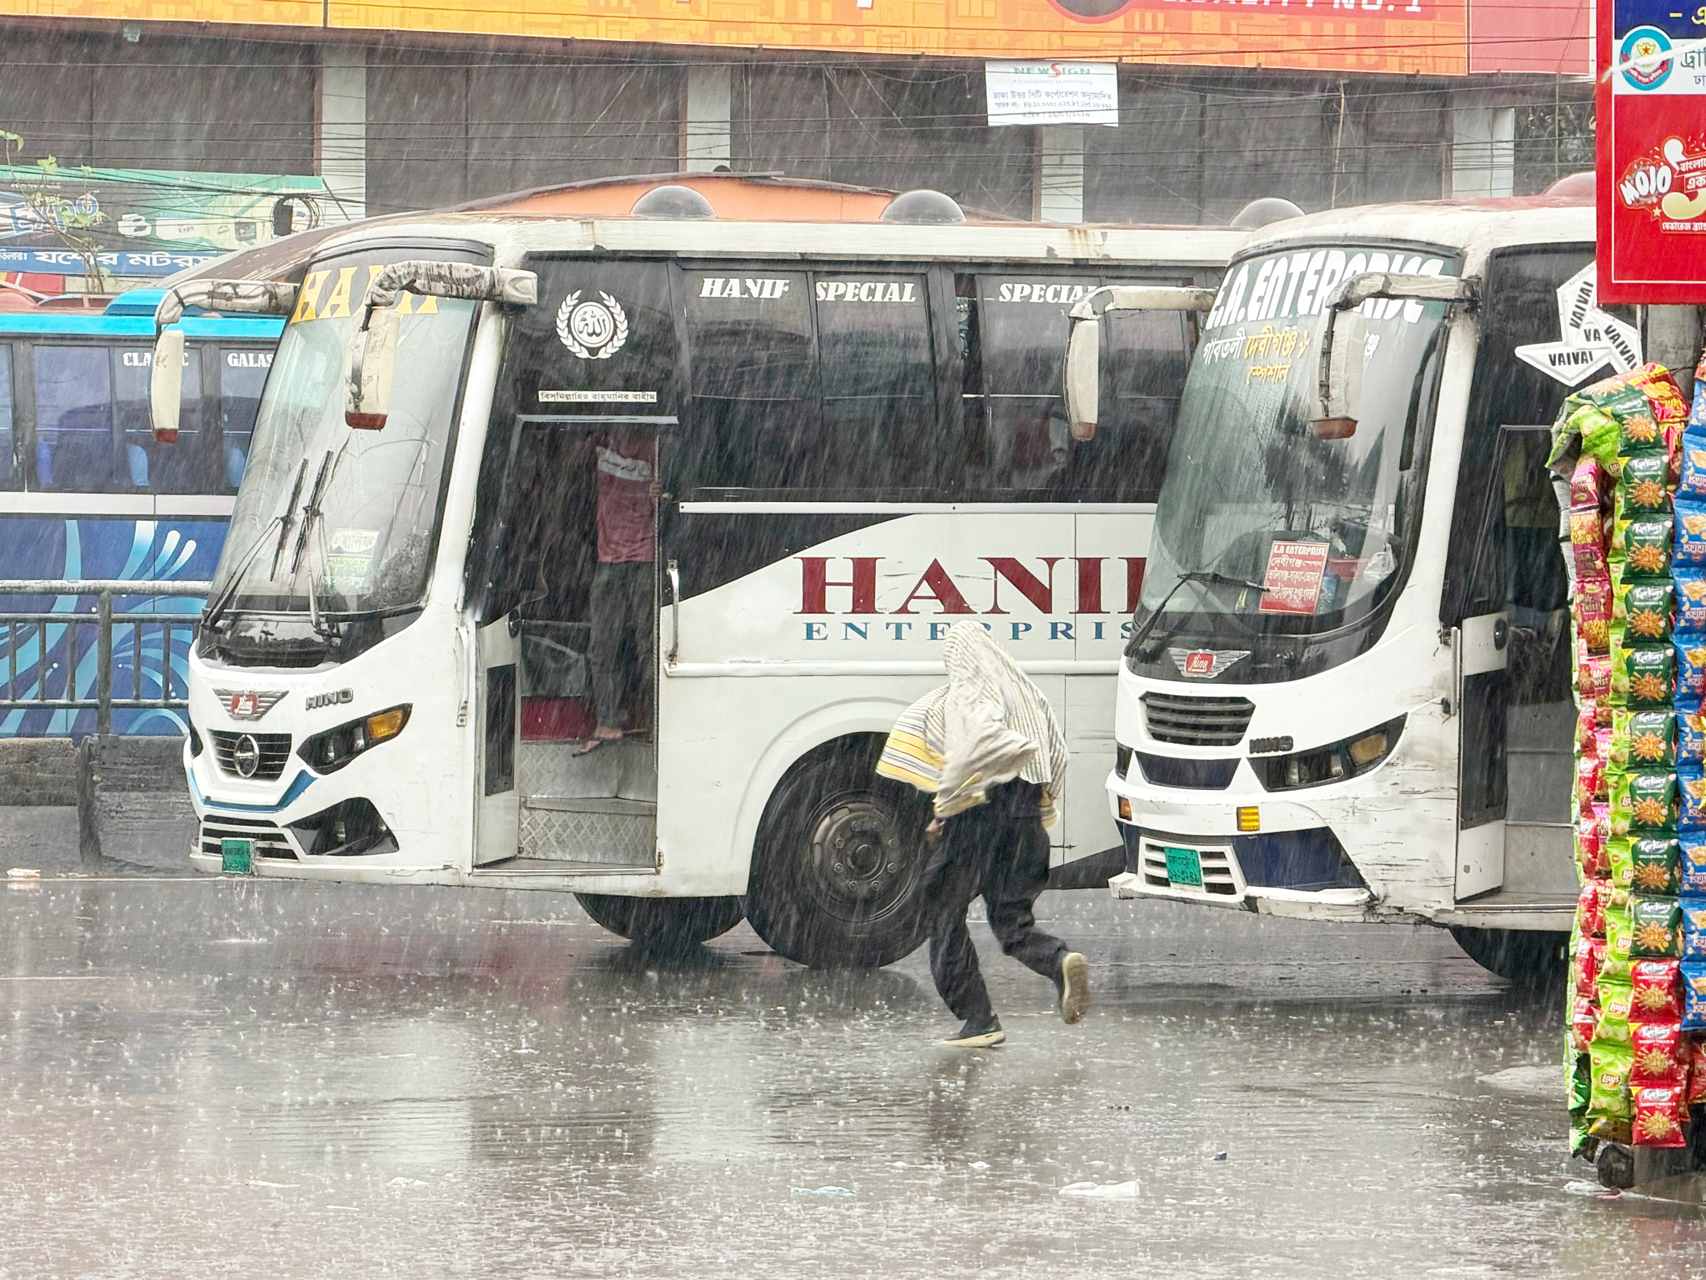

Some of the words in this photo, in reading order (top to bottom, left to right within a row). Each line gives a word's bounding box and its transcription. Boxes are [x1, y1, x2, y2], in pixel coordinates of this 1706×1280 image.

[1620, 165, 1672, 205] MOJO
[699, 277, 790, 299] HANIF
[816, 281, 916, 303] SPECIAL
[1569, 280, 1595, 330] VAIVAI
[1548, 350, 1594, 367] VAIVAI
[1286, 545, 1327, 556] ENTERPRISE
[305, 687, 354, 711] HINO
